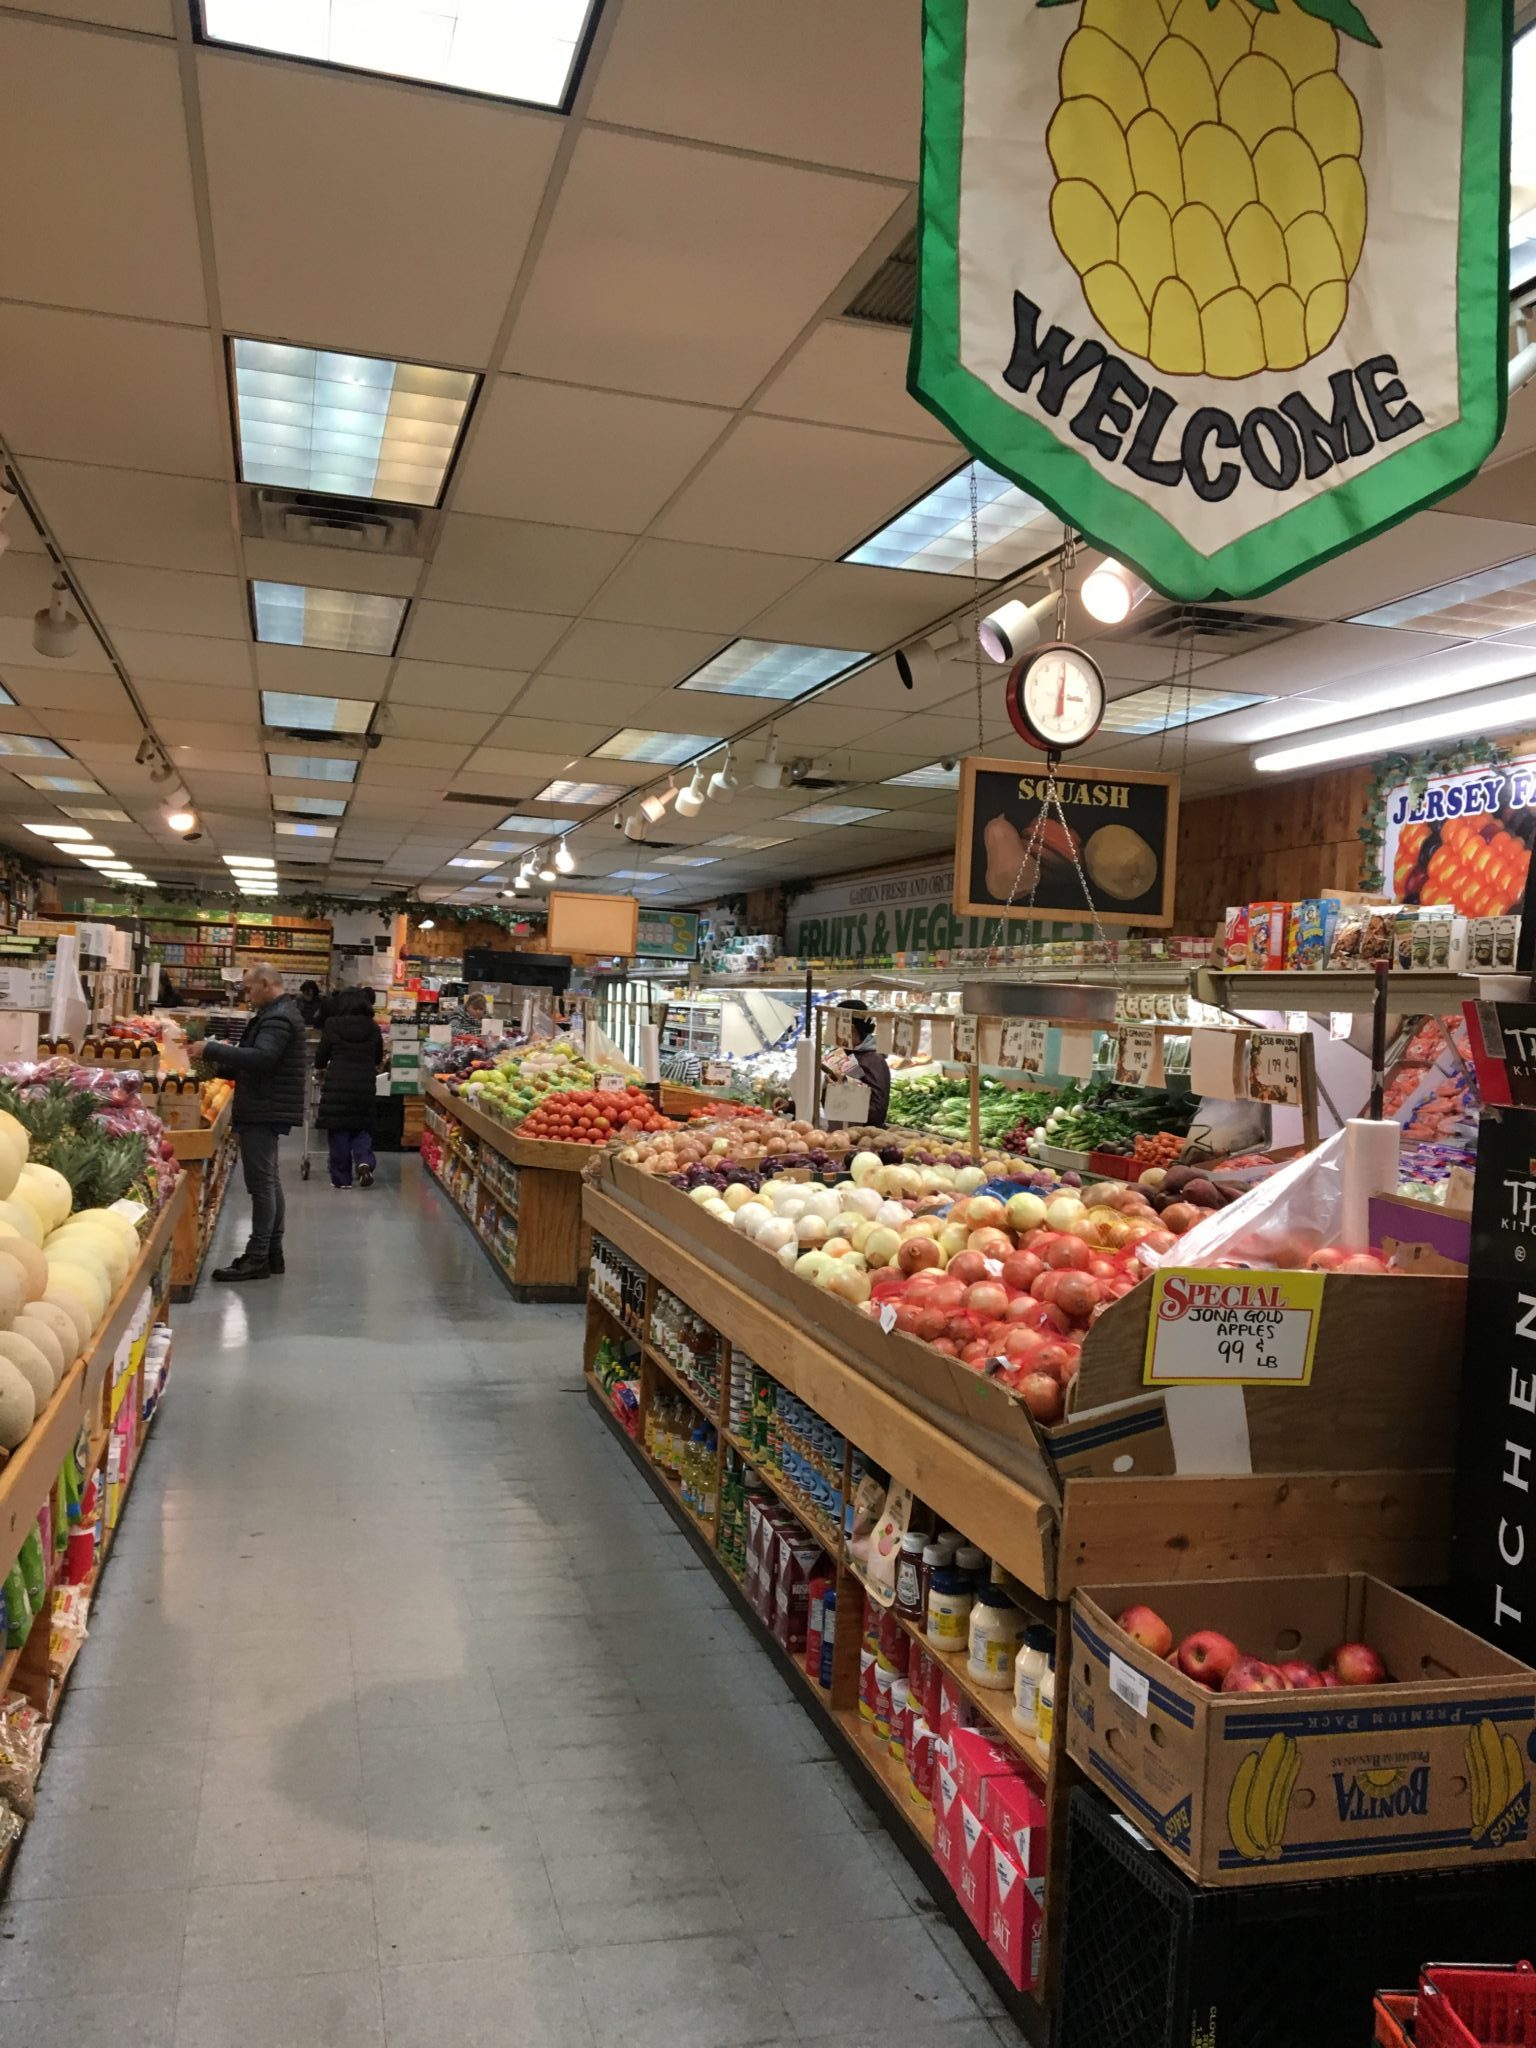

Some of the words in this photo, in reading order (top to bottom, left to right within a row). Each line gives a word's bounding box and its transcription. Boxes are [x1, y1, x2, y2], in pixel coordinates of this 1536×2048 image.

[1002, 290, 1424, 502] WELCOME
[1018, 778, 1130, 808] SQUASH
[881, 880, 907, 901] FRESH
[910, 878, 928, 898] AND
[800, 912, 868, 957] FRUITS
[872, 910, 891, 954] &
[1188, 1309, 1239, 1323] JONA
[1244, 1310, 1283, 1324] GOLD
[1217, 1323, 1275, 1339] APPLES
[1218, 1340, 1245, 1364] 99
[1257, 1356, 1278, 1368] LB
[1308, 1714, 1360, 1730] PACK
[1372, 1707, 1461, 1725] PREMIUM
[1332, 1766, 1432, 1822] BONITA
[1164, 1805, 1191, 1843] BAGS
[1489, 1796, 1528, 1847] BAGS
[961, 1864, 976, 1905] SALT
[992, 1910, 1011, 1954] SALT
